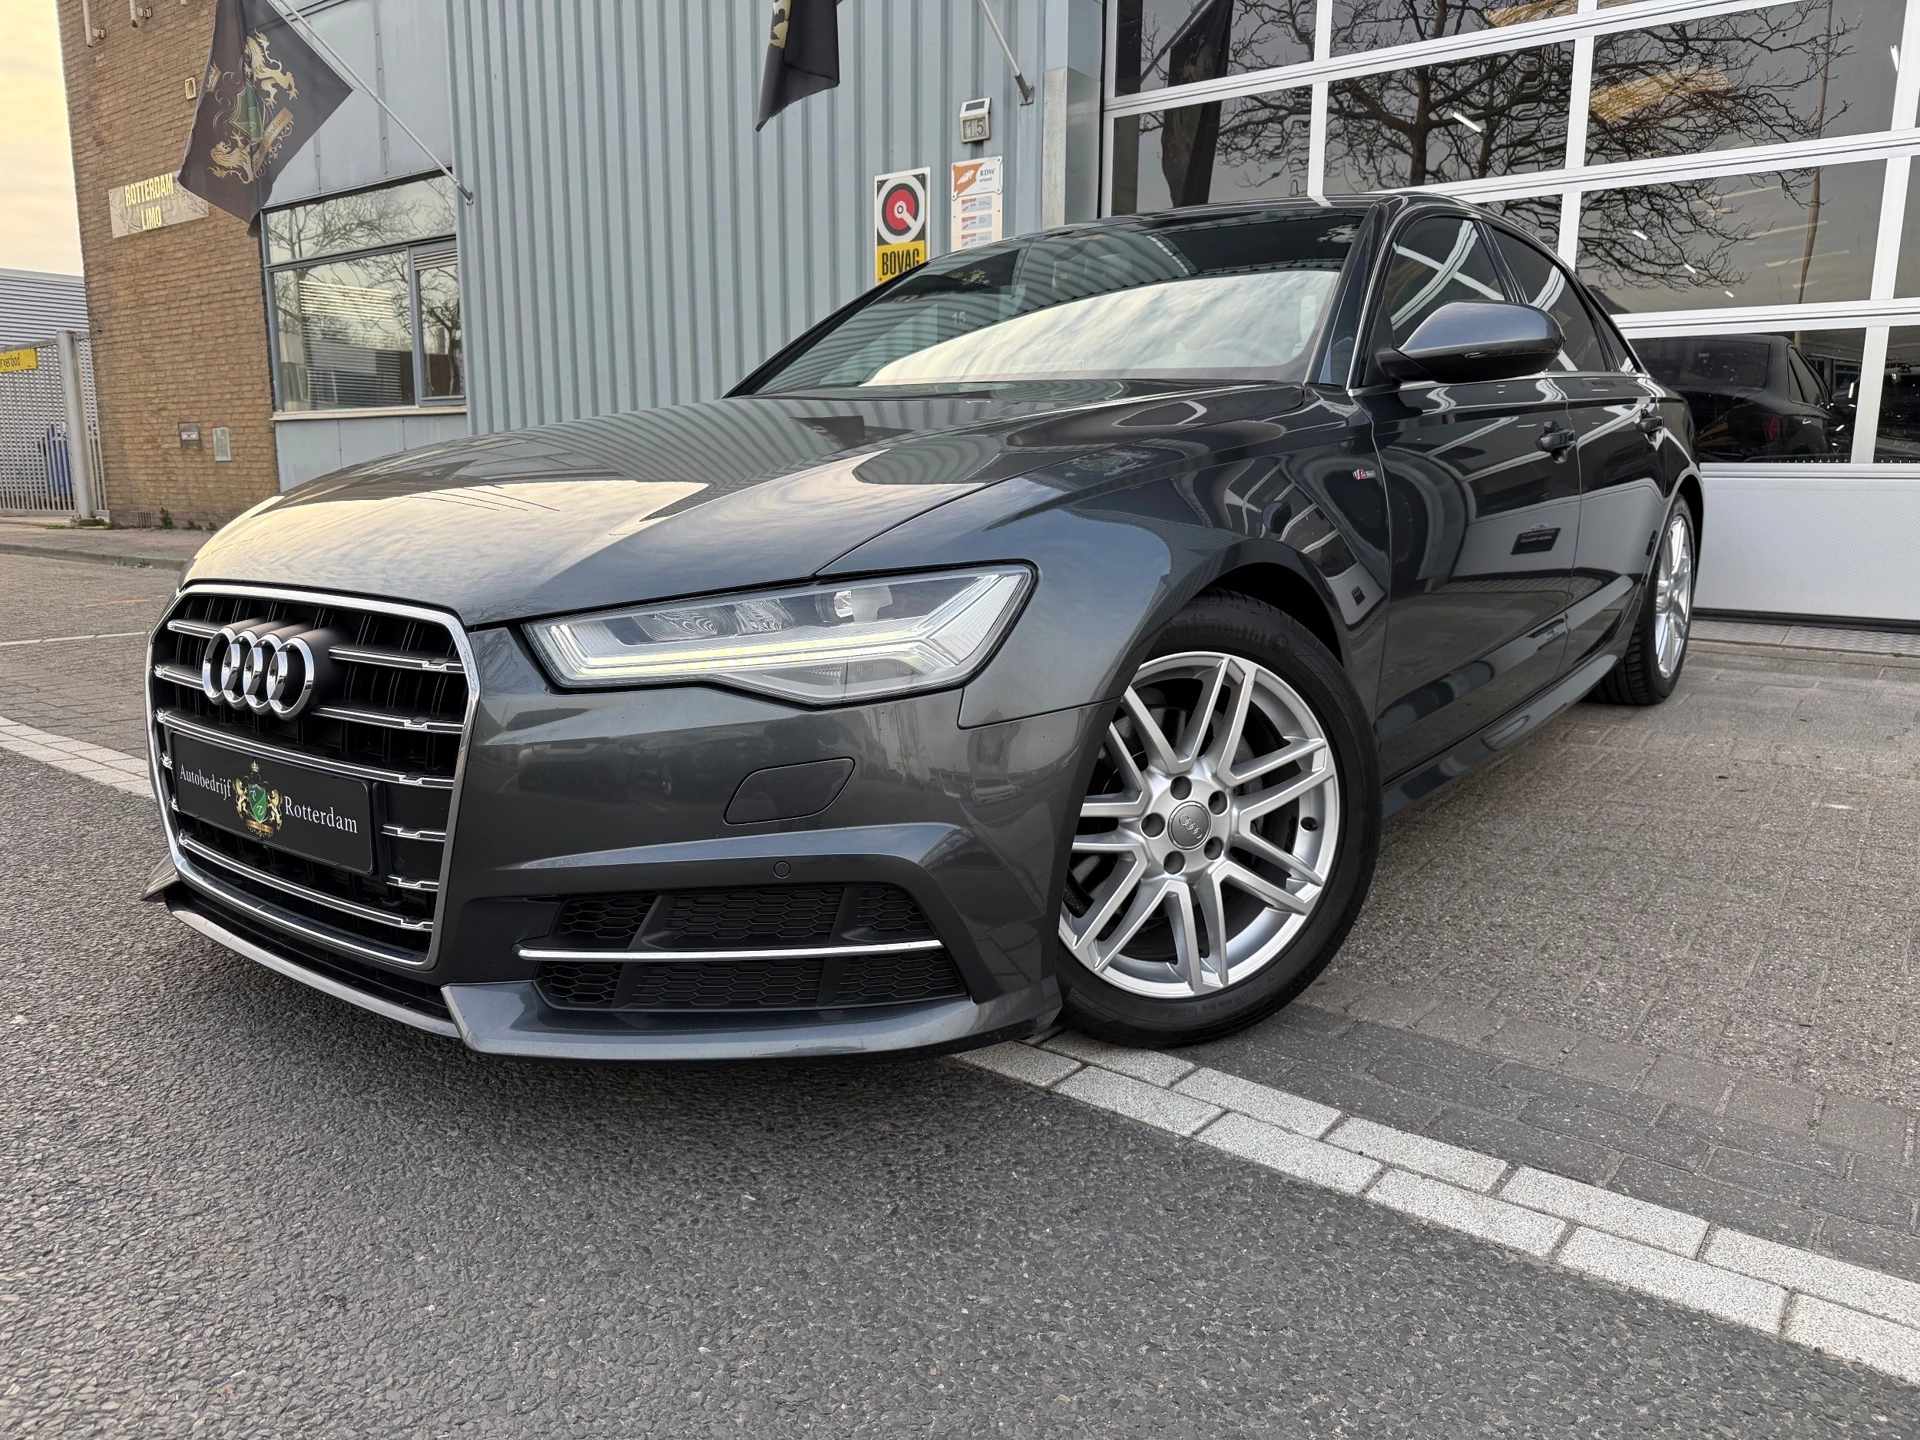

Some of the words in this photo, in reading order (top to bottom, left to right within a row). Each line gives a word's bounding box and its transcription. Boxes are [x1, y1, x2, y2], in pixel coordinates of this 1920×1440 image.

[968, 119, 984, 137] 15
[980, 168, 995, 177] RDW
[124, 172, 174, 207] ROTTERDAM
[141, 205, 162, 231] LIMO
[881, 247, 920, 276] BOVAG
[179, 764, 232, 801] Autobedrijf
[284, 795, 358, 834] Rotterdam
